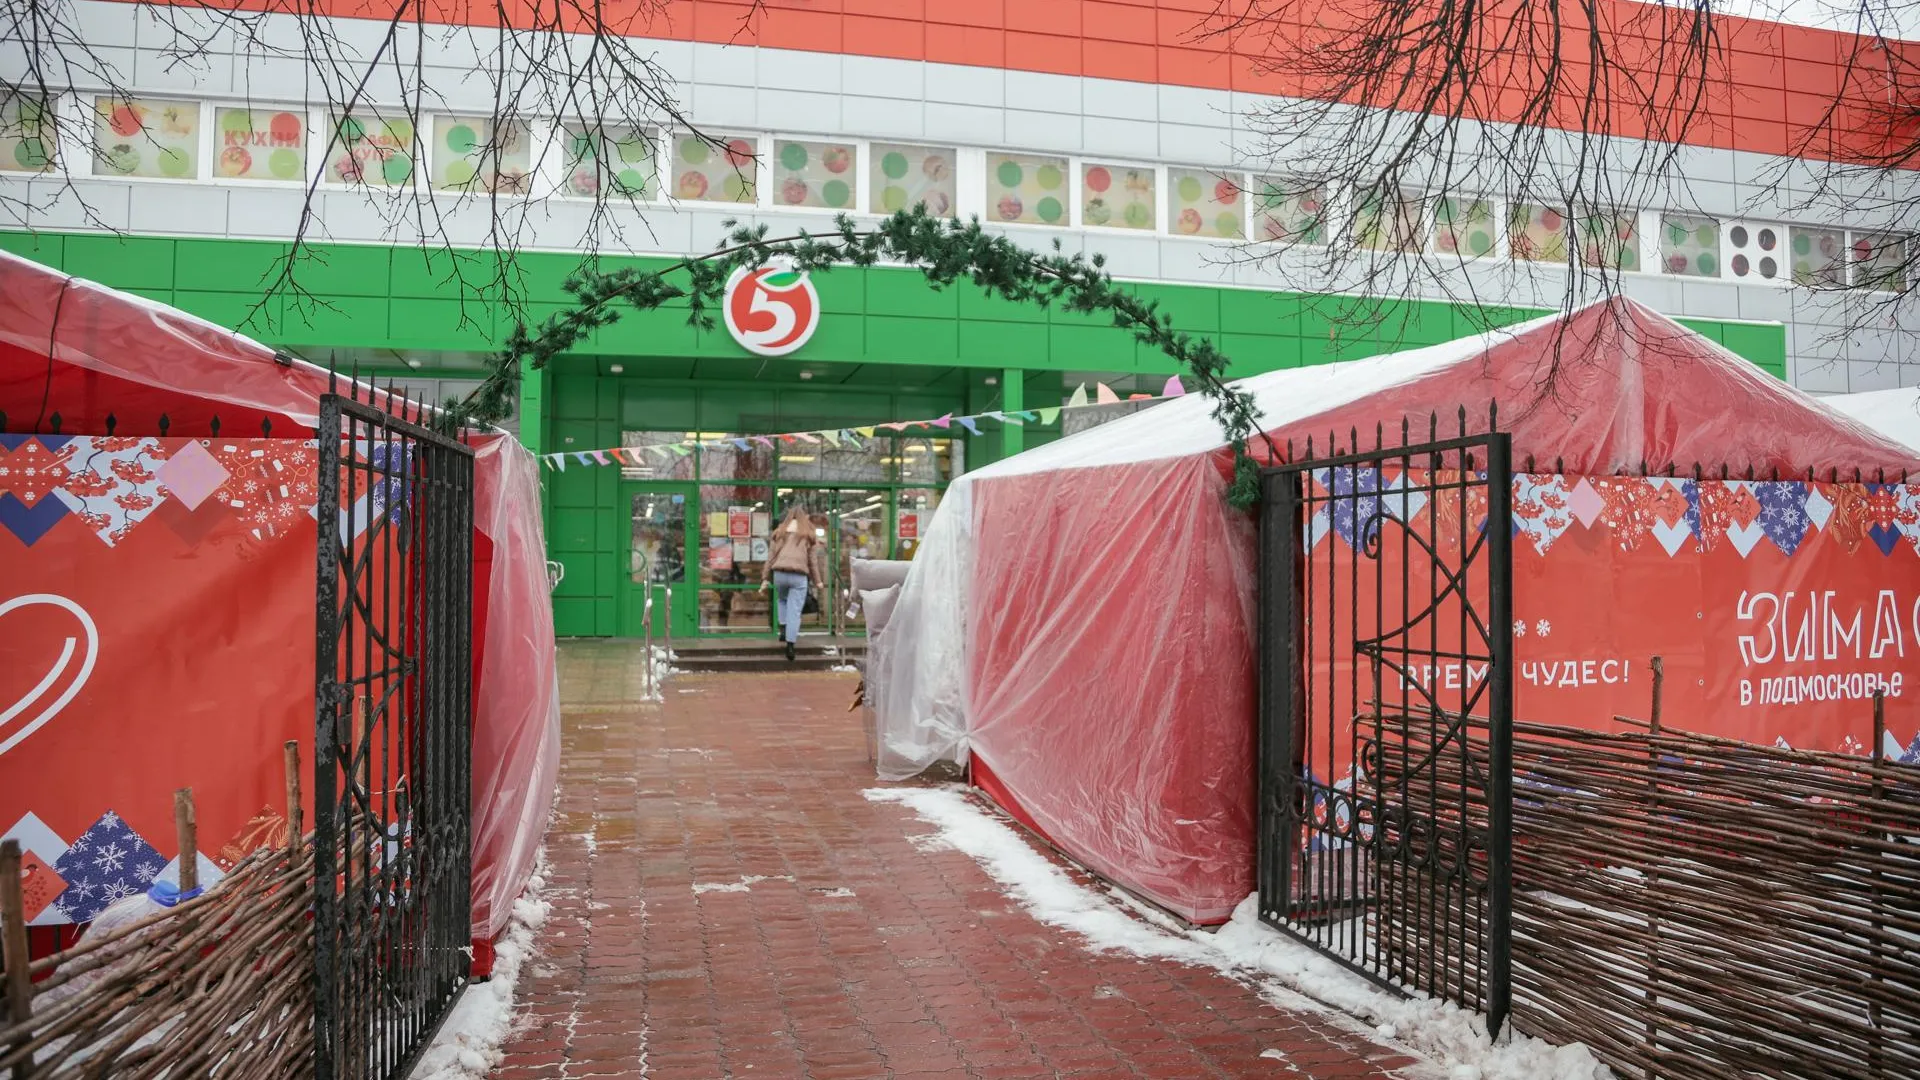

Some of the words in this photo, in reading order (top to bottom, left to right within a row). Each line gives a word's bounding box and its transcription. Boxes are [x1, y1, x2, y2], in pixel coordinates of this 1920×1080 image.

[225, 129, 301, 148] КУХНИ
[743, 287, 797, 347] 5
[1736, 589, 1904, 668] ЗИМА
[1399, 663, 1490, 691] ВРЕМ
[1522, 659, 1630, 689] ЧУДЕС!
